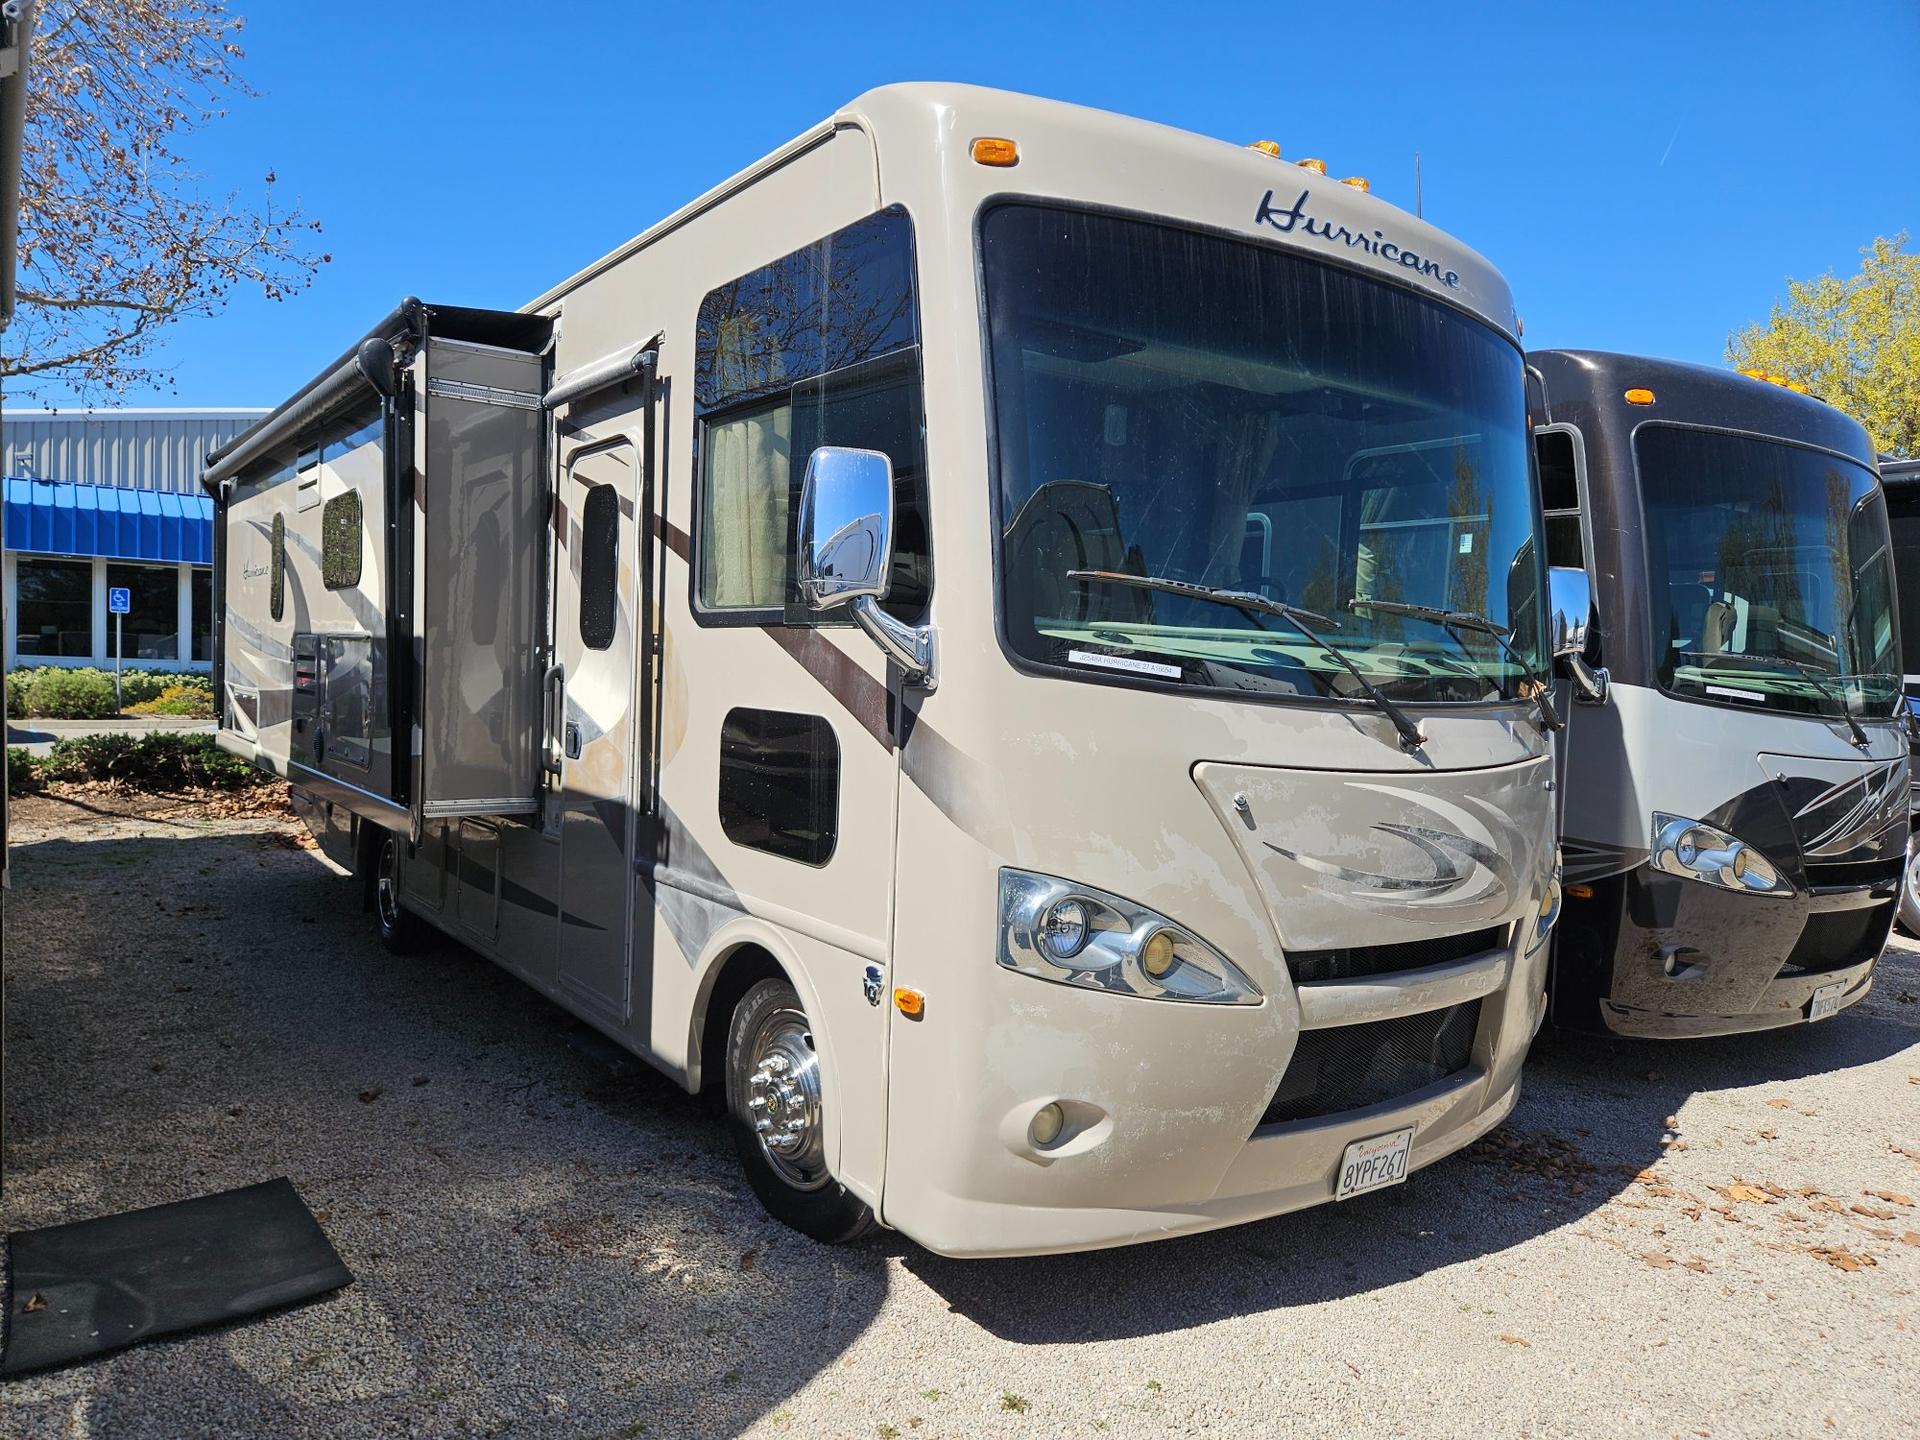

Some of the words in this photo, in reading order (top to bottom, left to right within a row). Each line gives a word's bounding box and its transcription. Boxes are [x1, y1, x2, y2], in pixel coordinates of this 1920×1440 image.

[1255, 190, 1461, 290] Hurricane
[243, 559, 269, 580] Hicane
[1343, 1149, 1406, 1189] 8YPF267
